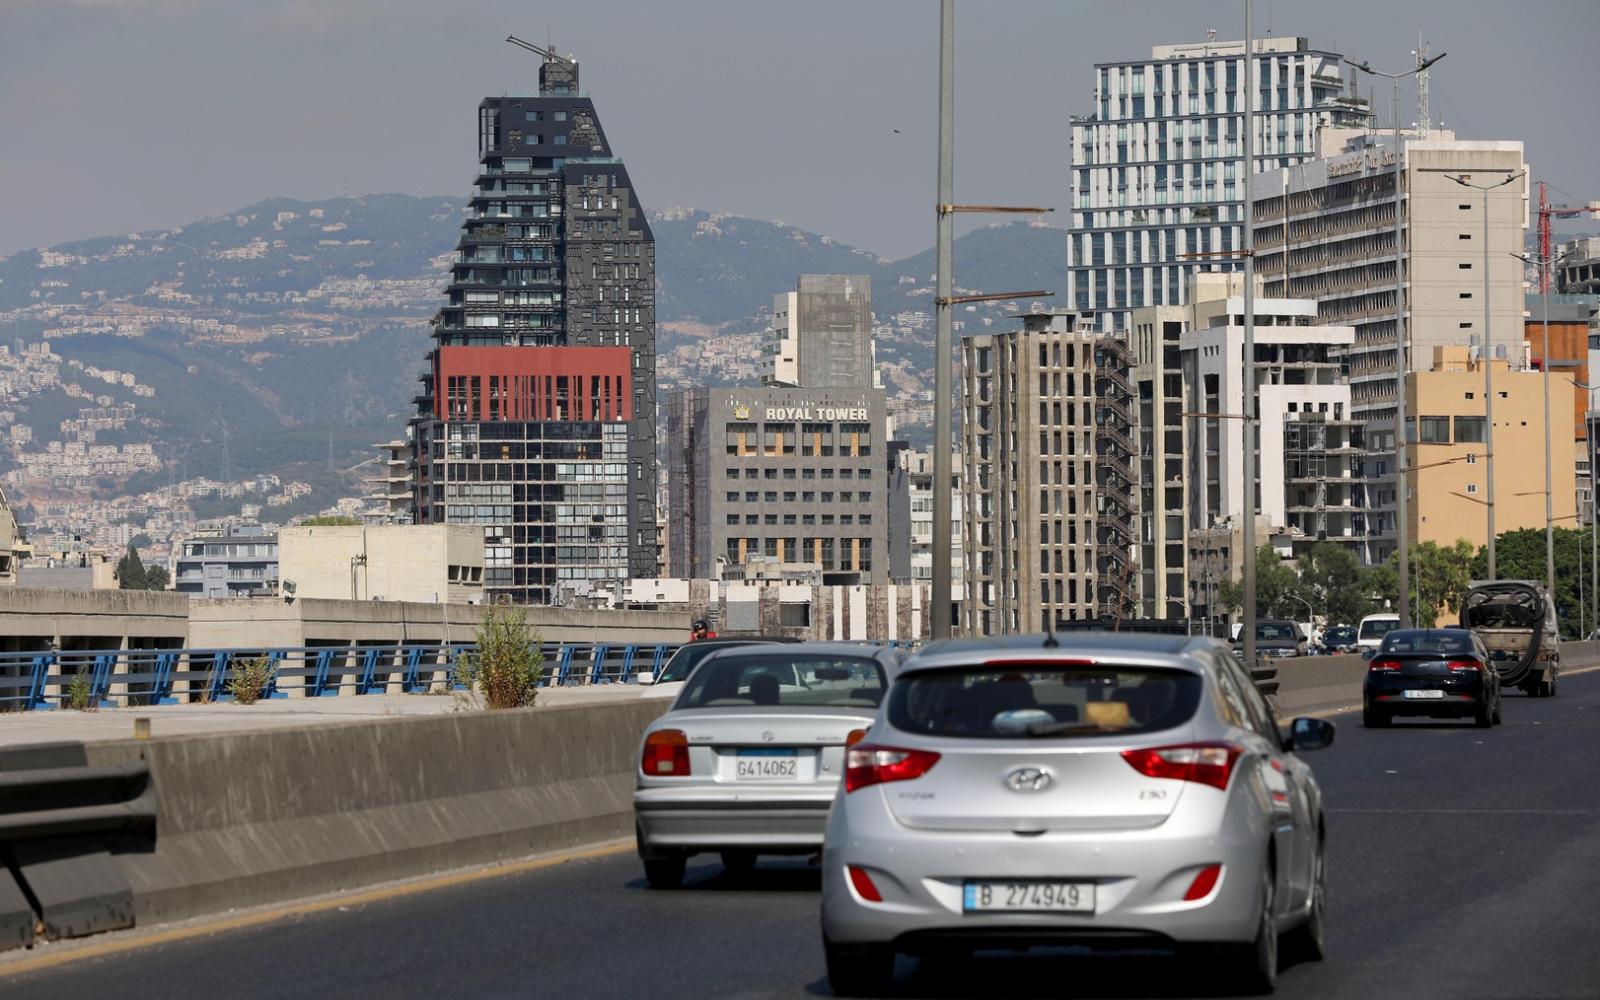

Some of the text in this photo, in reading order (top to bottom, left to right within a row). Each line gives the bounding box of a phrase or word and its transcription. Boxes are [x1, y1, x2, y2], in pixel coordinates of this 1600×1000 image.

[766, 407, 868, 421] ROYAL TOWER
[737, 760, 796, 776] G414062
[981, 883, 1080, 906] B 274949
